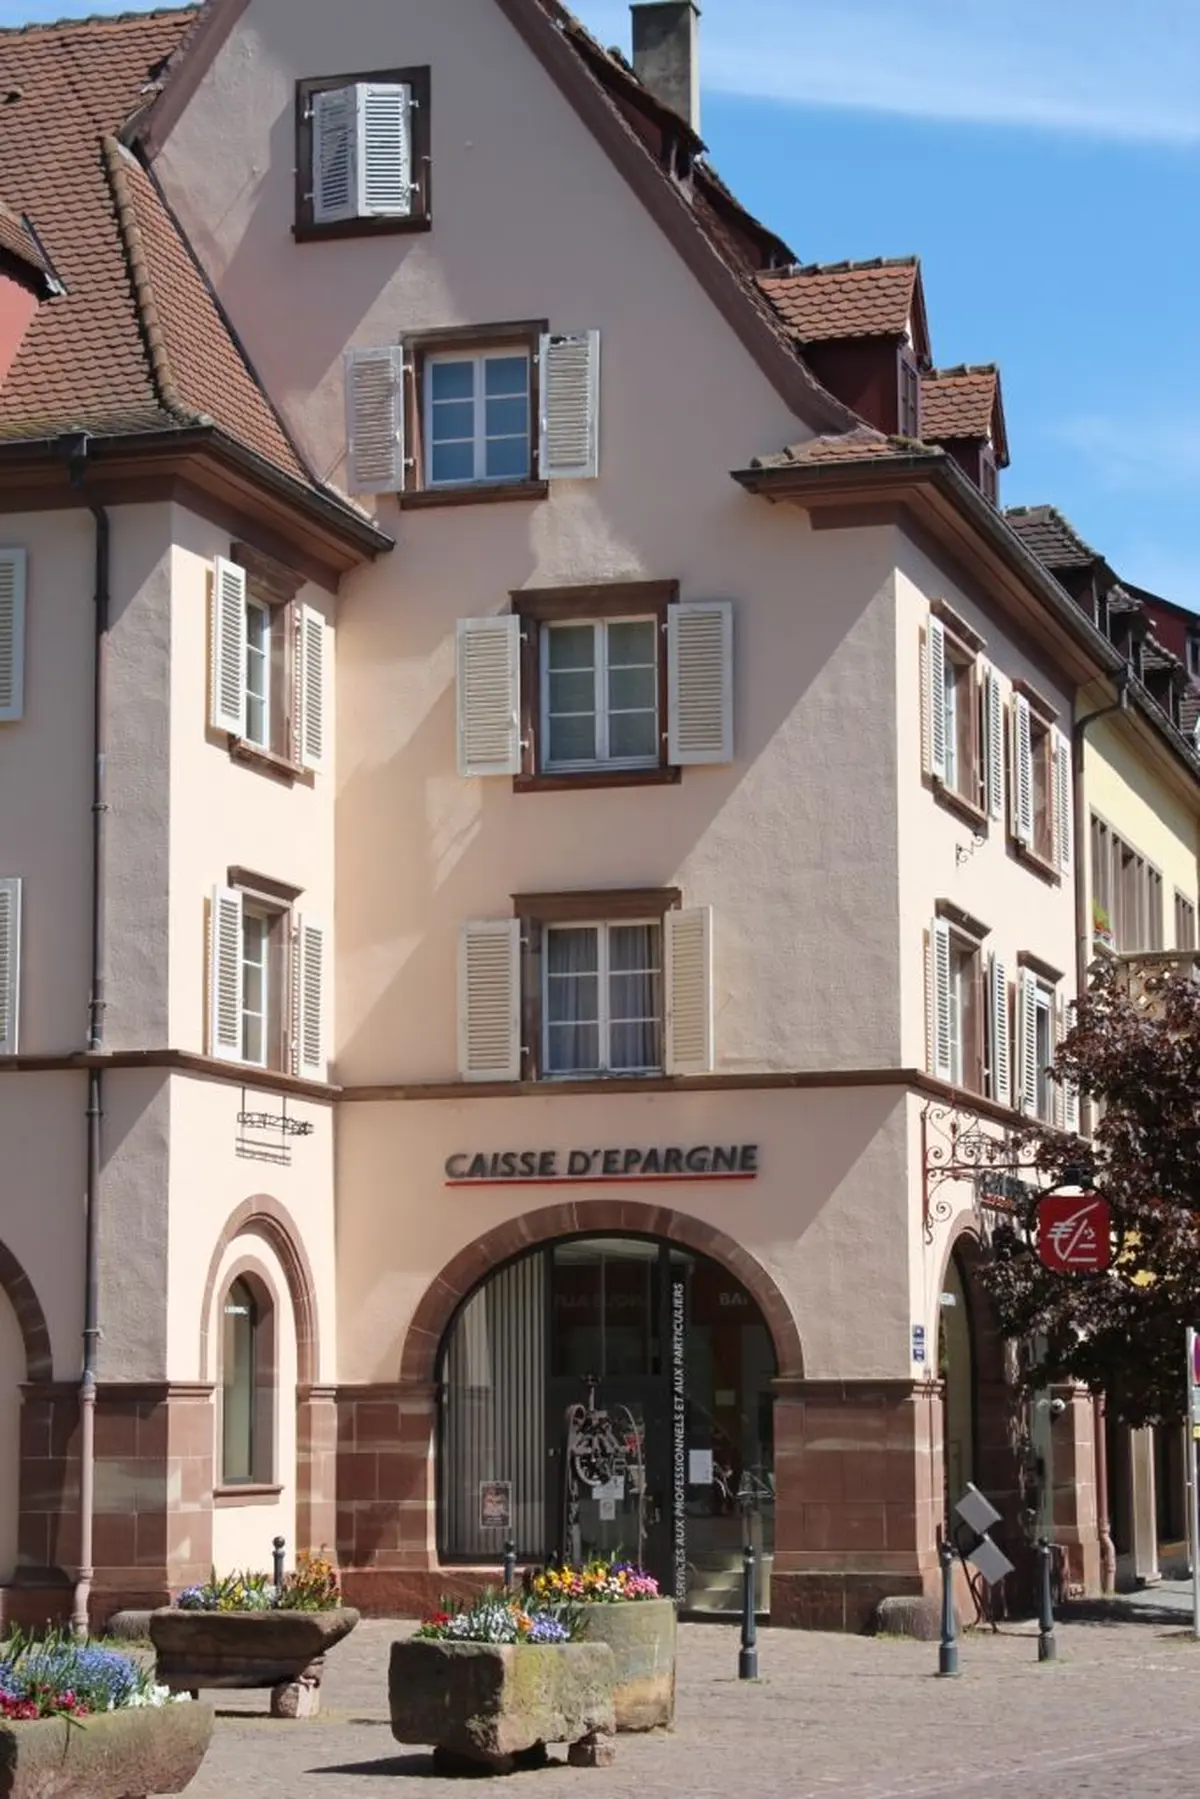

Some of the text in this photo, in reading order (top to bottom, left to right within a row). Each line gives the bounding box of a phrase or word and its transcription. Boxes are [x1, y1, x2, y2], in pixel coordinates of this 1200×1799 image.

[444, 1145, 758, 1179] CAISSE D'EPARGNE
[673, 1283, 686, 1603] SERVICES AUX PROFESSIONNELS ET AUX PARTICULIERS
